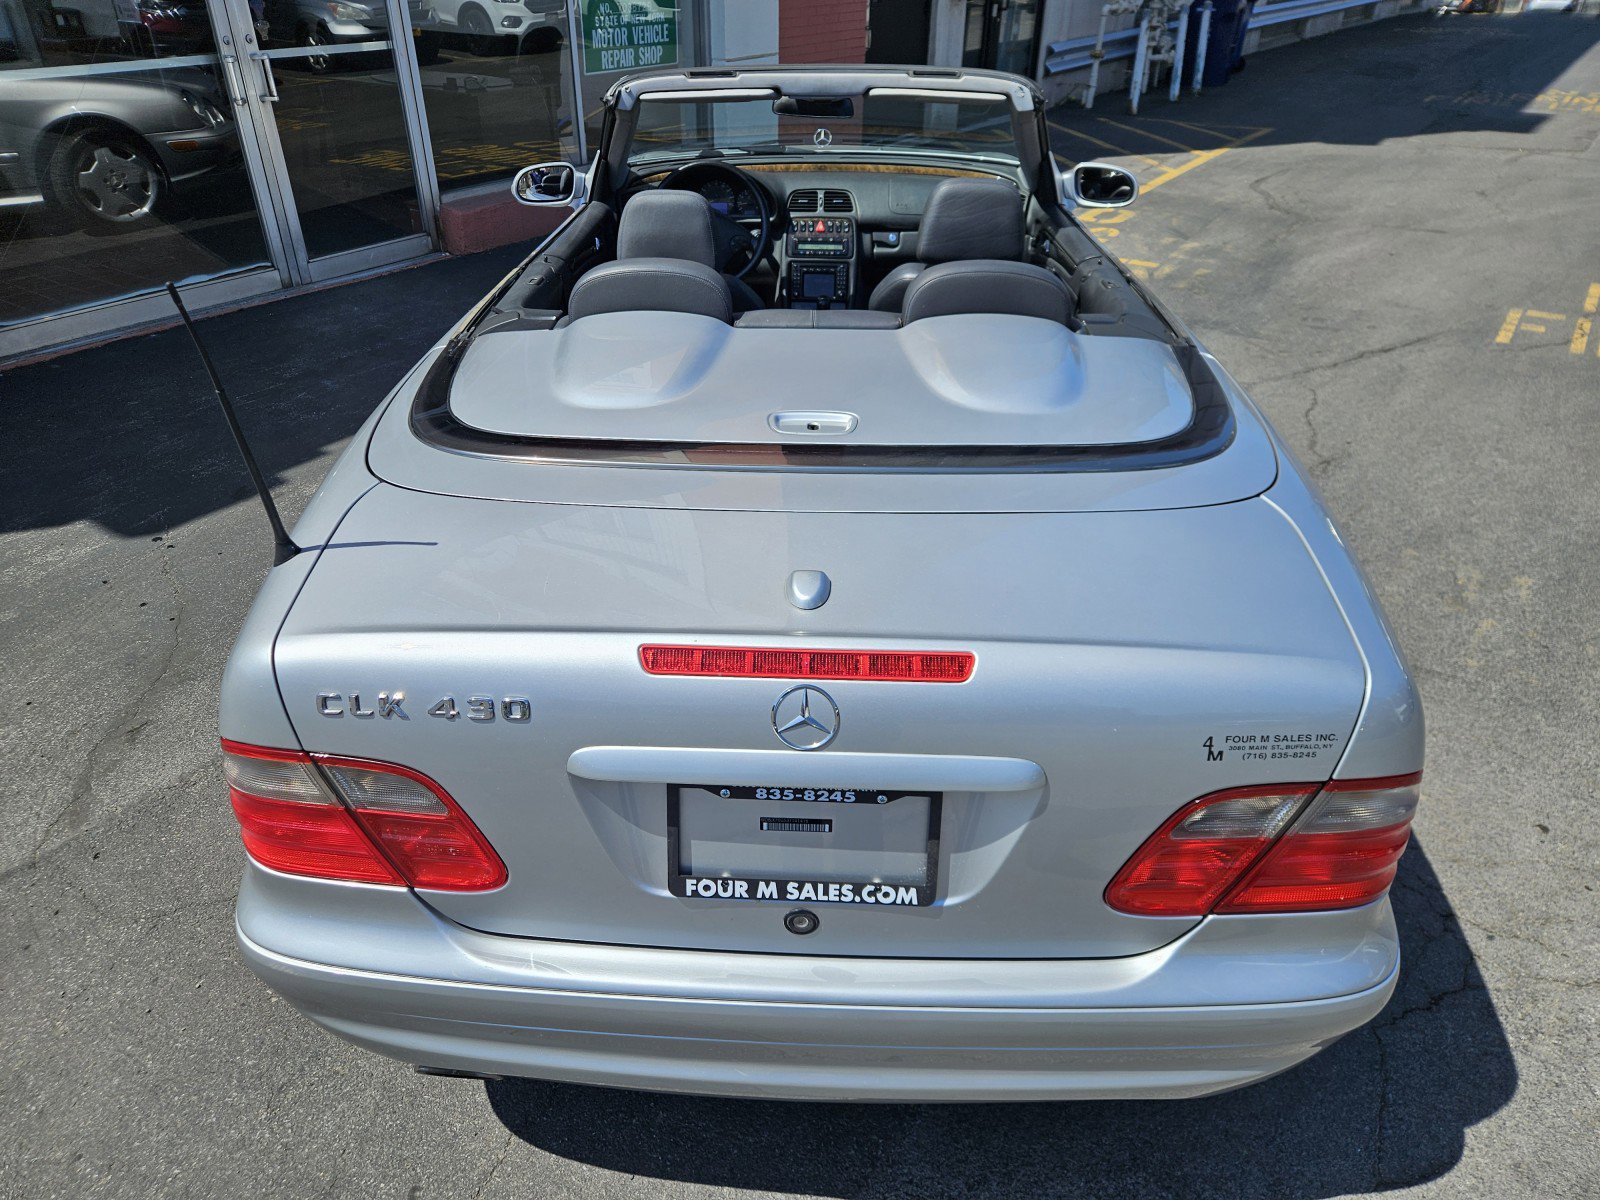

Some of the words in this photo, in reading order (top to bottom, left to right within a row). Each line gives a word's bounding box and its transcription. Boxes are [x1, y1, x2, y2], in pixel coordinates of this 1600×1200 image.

[595, 15, 618, 27] STATE
[620, 15, 628, 25] OF
[631, 14, 646, 24] NEW
[648, 12, 665, 23] YORK
[592, 28, 628, 49] MOTOR
[632, 24, 669, 45] VEHICLE
[601, 48, 635, 69] REPAIR
[639, 45, 663, 65] SHOP
[316, 691, 410, 720] CLK
[428, 696, 532, 722] 430
[1225, 735, 1257, 744] FOUR
[1260, 735, 1270, 743] M
[1273, 734, 1312, 743] SALES
[1315, 733, 1339, 742] INC.
[1207, 750, 1224, 761] M
[1242, 752, 1267, 760] (716)
[755, 788, 856, 803] 835-8245
[685, 878, 749, 899] FOUR
[756, 881, 779, 900] M
[786, 881, 918, 906] SALES.COM
